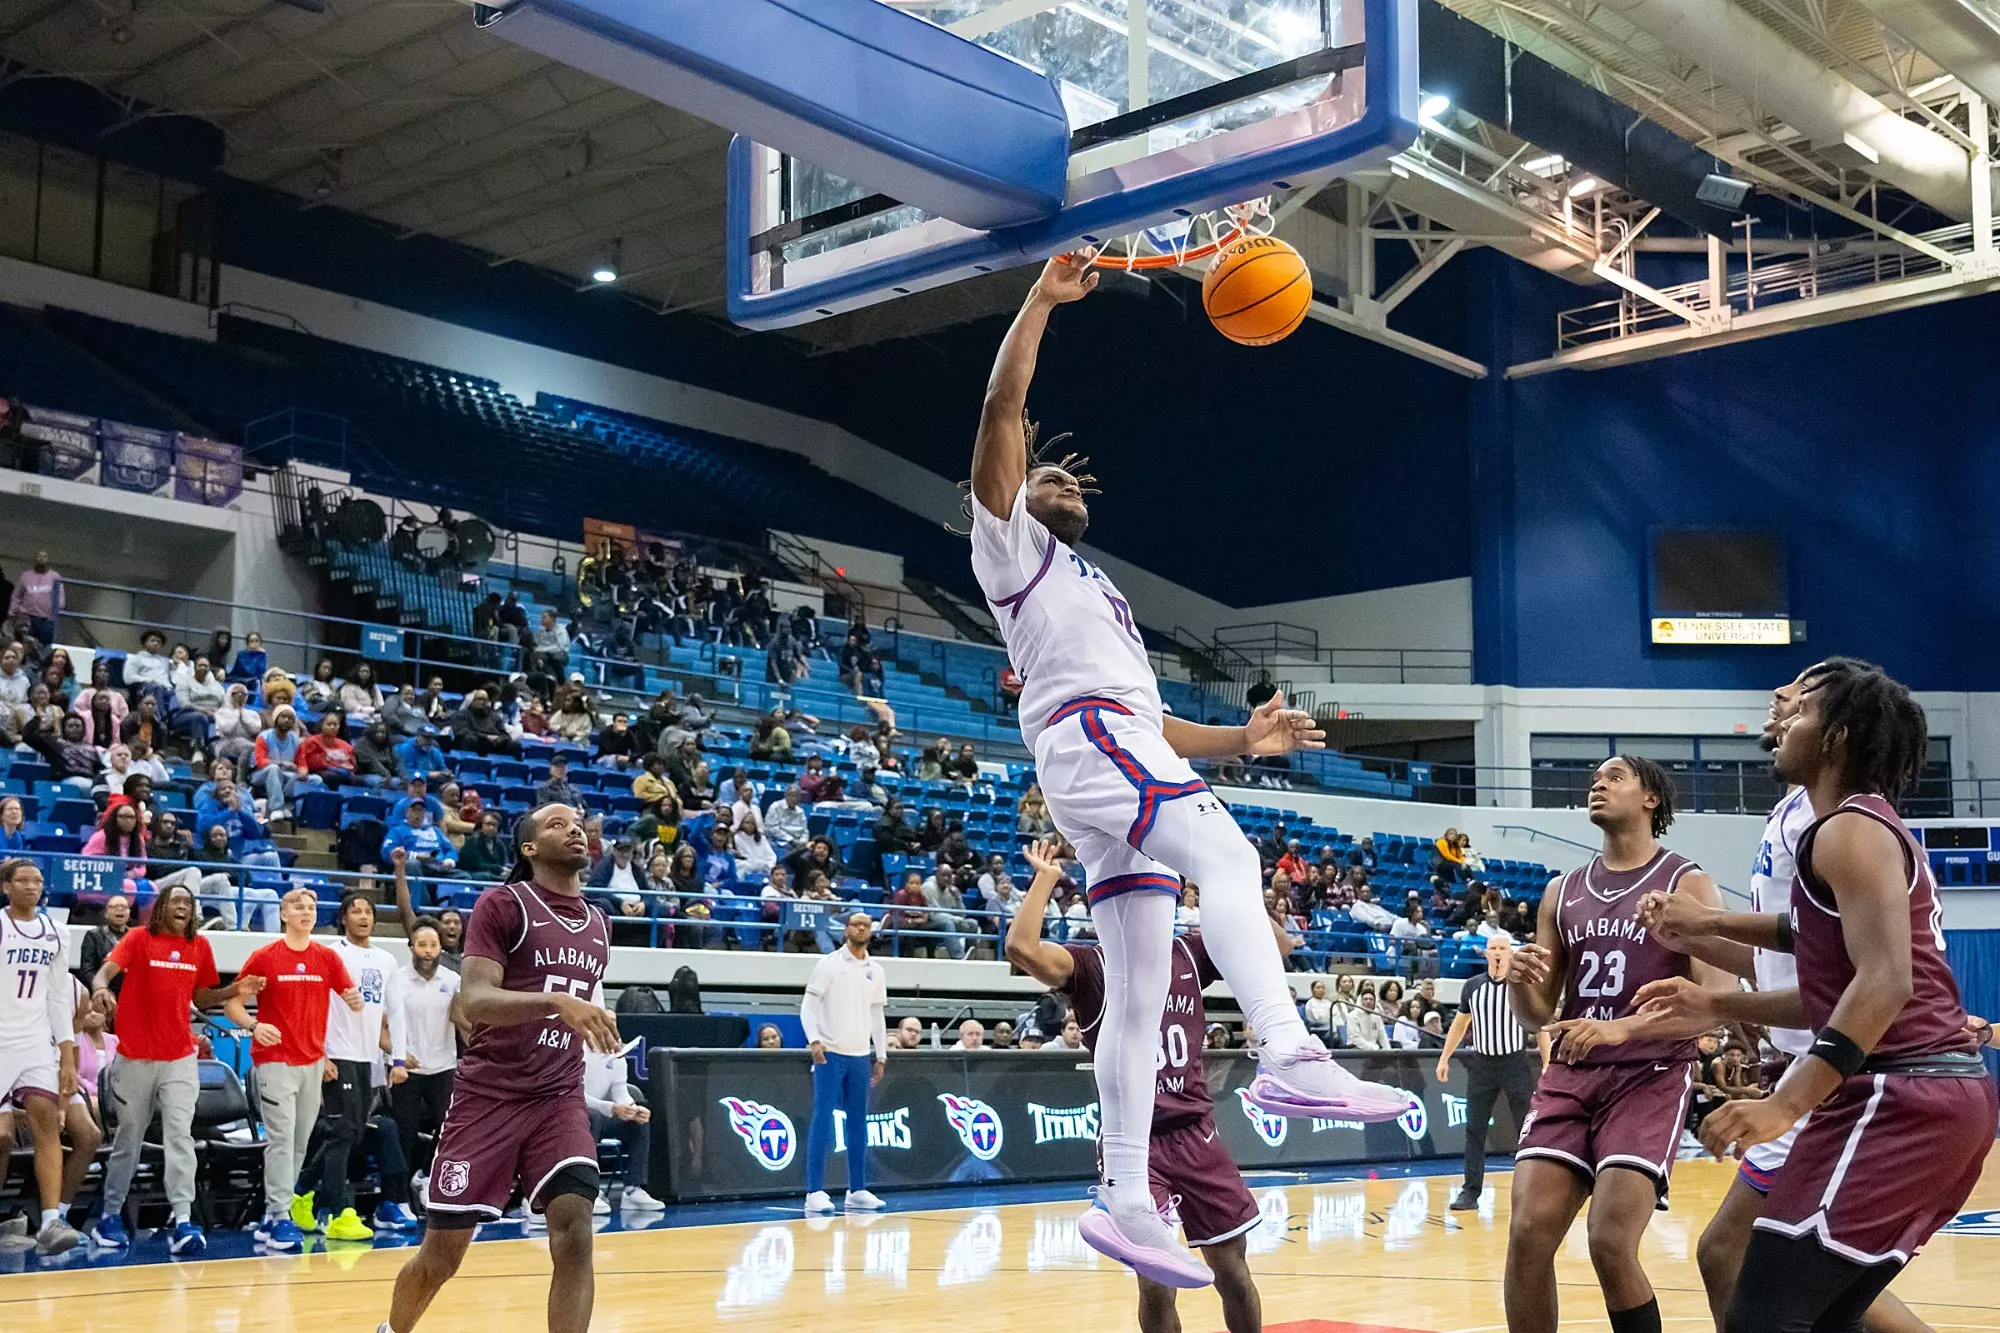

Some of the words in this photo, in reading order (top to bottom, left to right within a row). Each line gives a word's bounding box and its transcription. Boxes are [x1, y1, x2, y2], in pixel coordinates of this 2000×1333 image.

[1677, 622, 1744, 632] TENNESSEE
[1749, 622, 1784, 632] STATE
[1696, 632, 1763, 641] UNIVERSITY
[63, 859, 114, 873] SECTION
[72, 873, 103, 891] H-1
[793, 903, 824, 915] SECTION
[1567, 917, 1647, 948] ALABAMA
[7, 948, 55, 966] TIGERS
[149, 959, 198, 972] BASKETBALL
[534, 948, 603, 981] ALABAMA
[277, 974, 323, 983] BASKETBALL
[1578, 949, 1626, 997] 23
[538, 1028, 572, 1050] A&M
[1157, 1076, 1185, 1095] A&M
